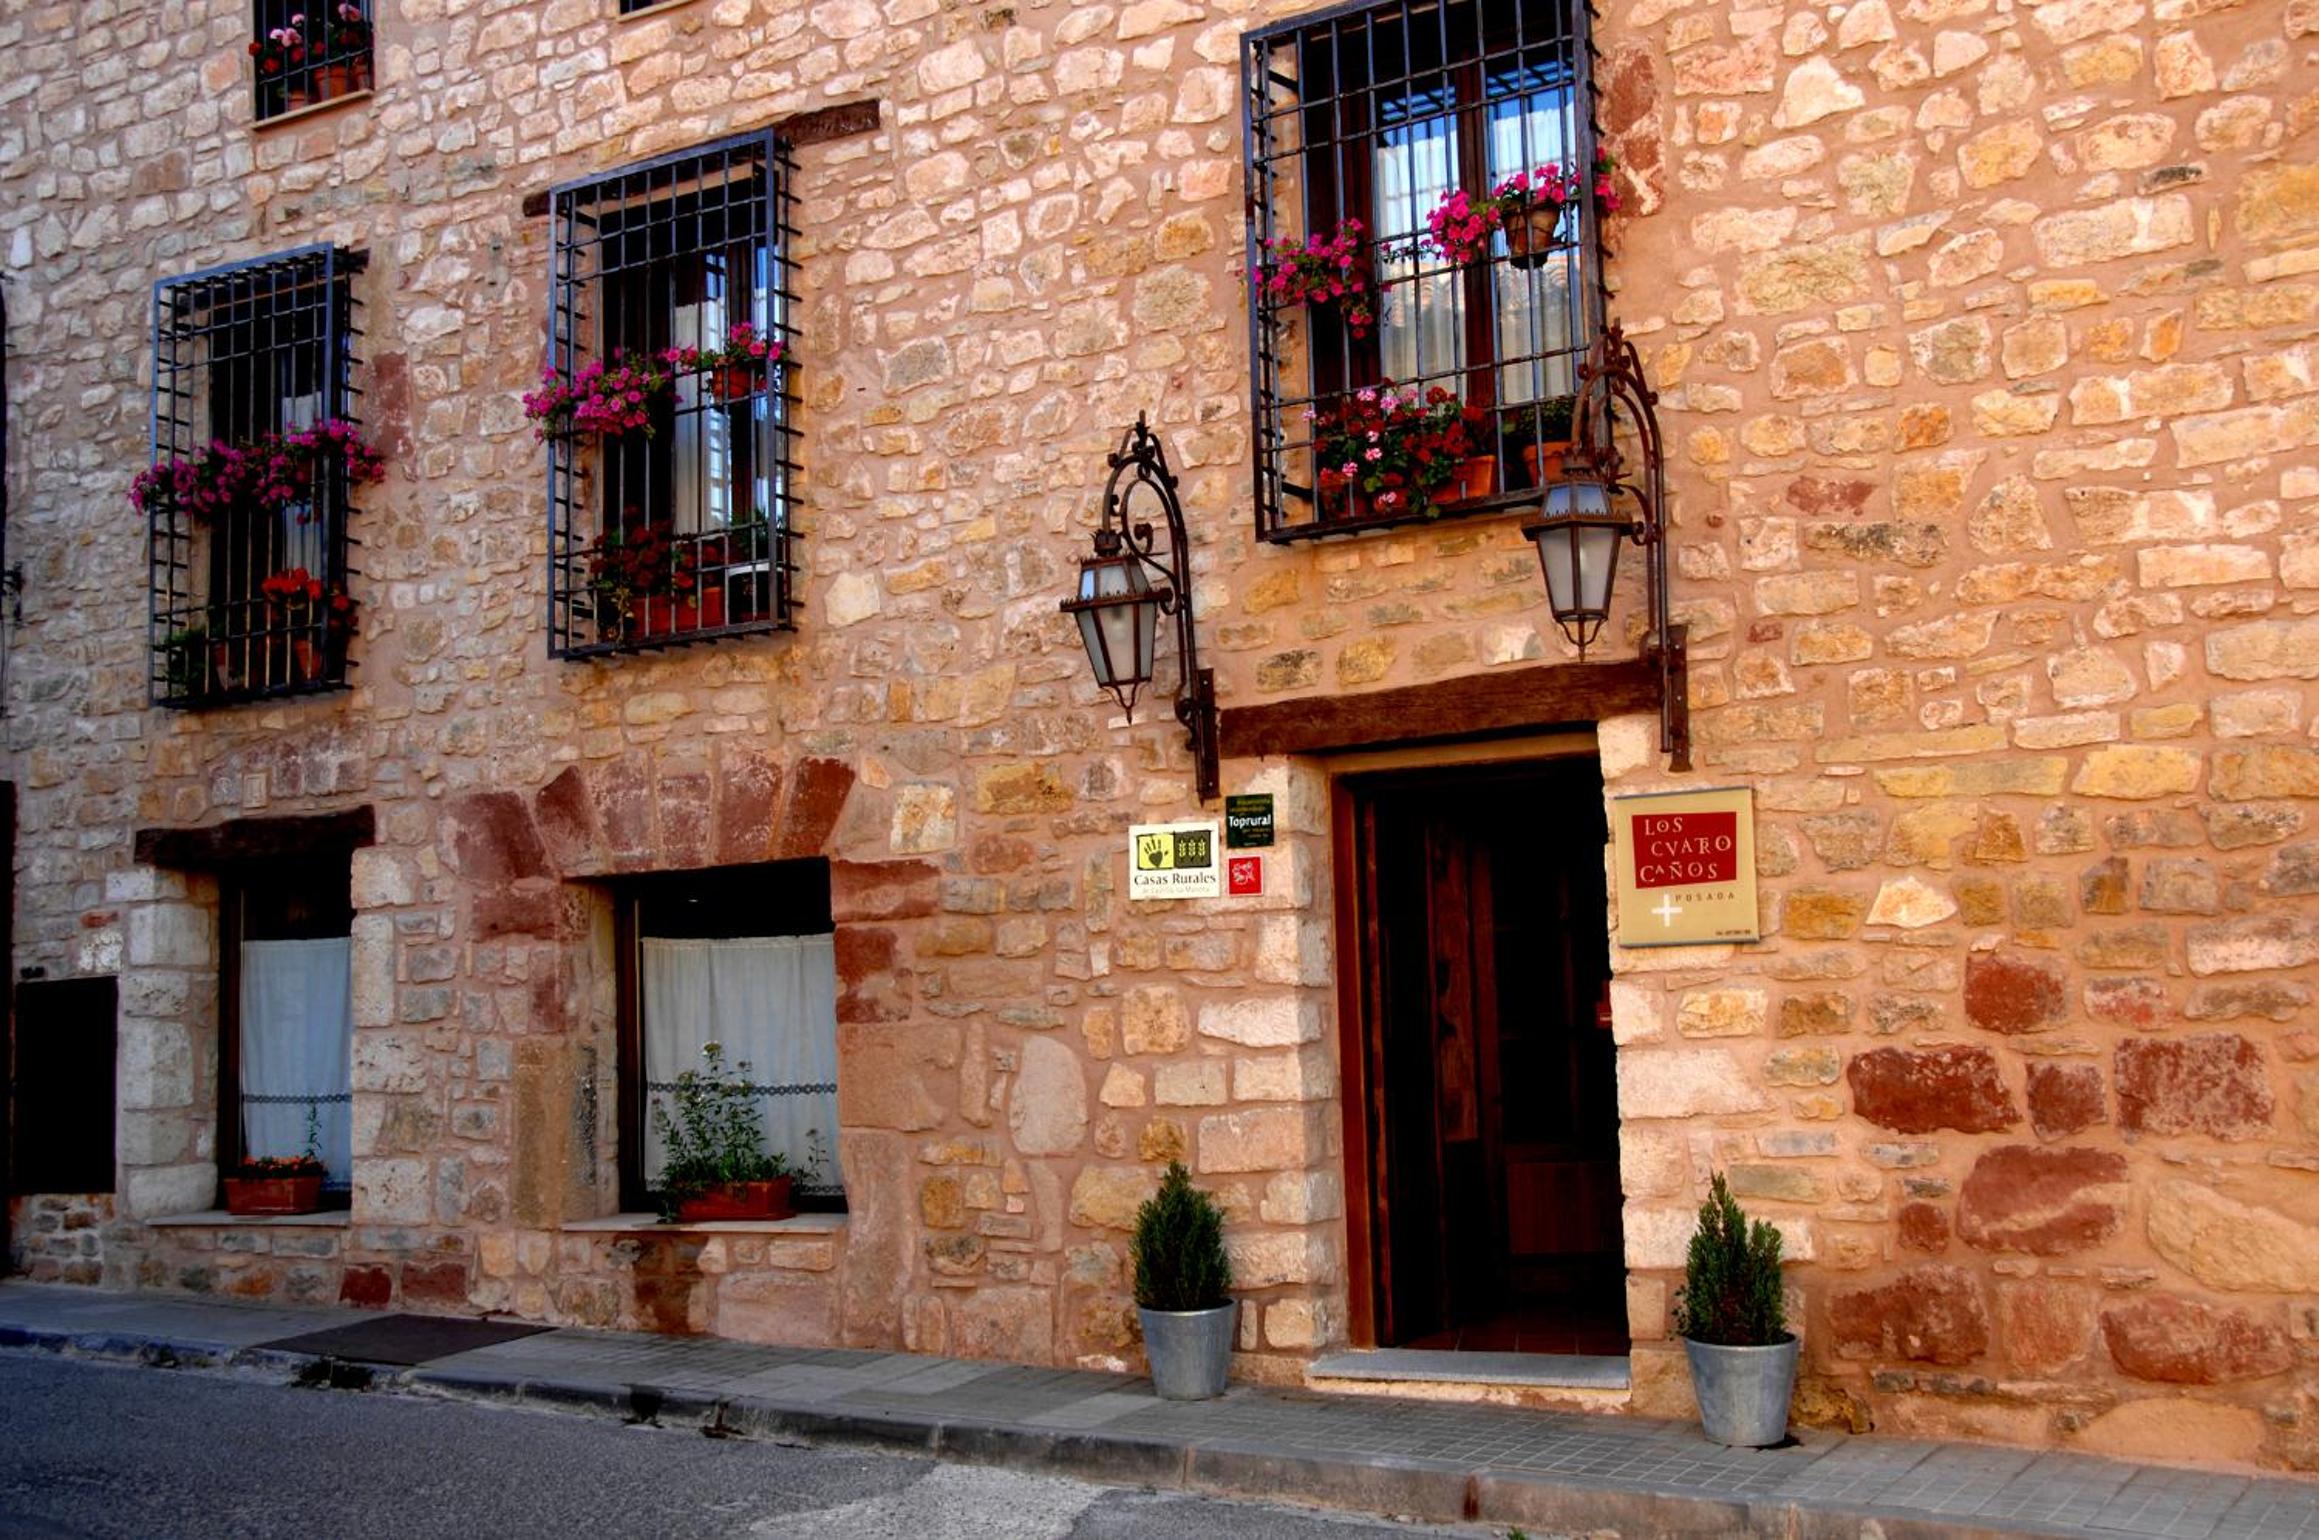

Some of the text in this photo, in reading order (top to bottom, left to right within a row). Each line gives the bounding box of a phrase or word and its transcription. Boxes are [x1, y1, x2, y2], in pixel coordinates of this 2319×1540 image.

[1228, 813, 1271, 829] Toprural
[1644, 817, 1683, 836] LOS
[1134, 872, 1216, 886] Casas Rurales
[1640, 861, 1719, 883] CAÑOS
[1675, 892, 1736, 903] POSADA
